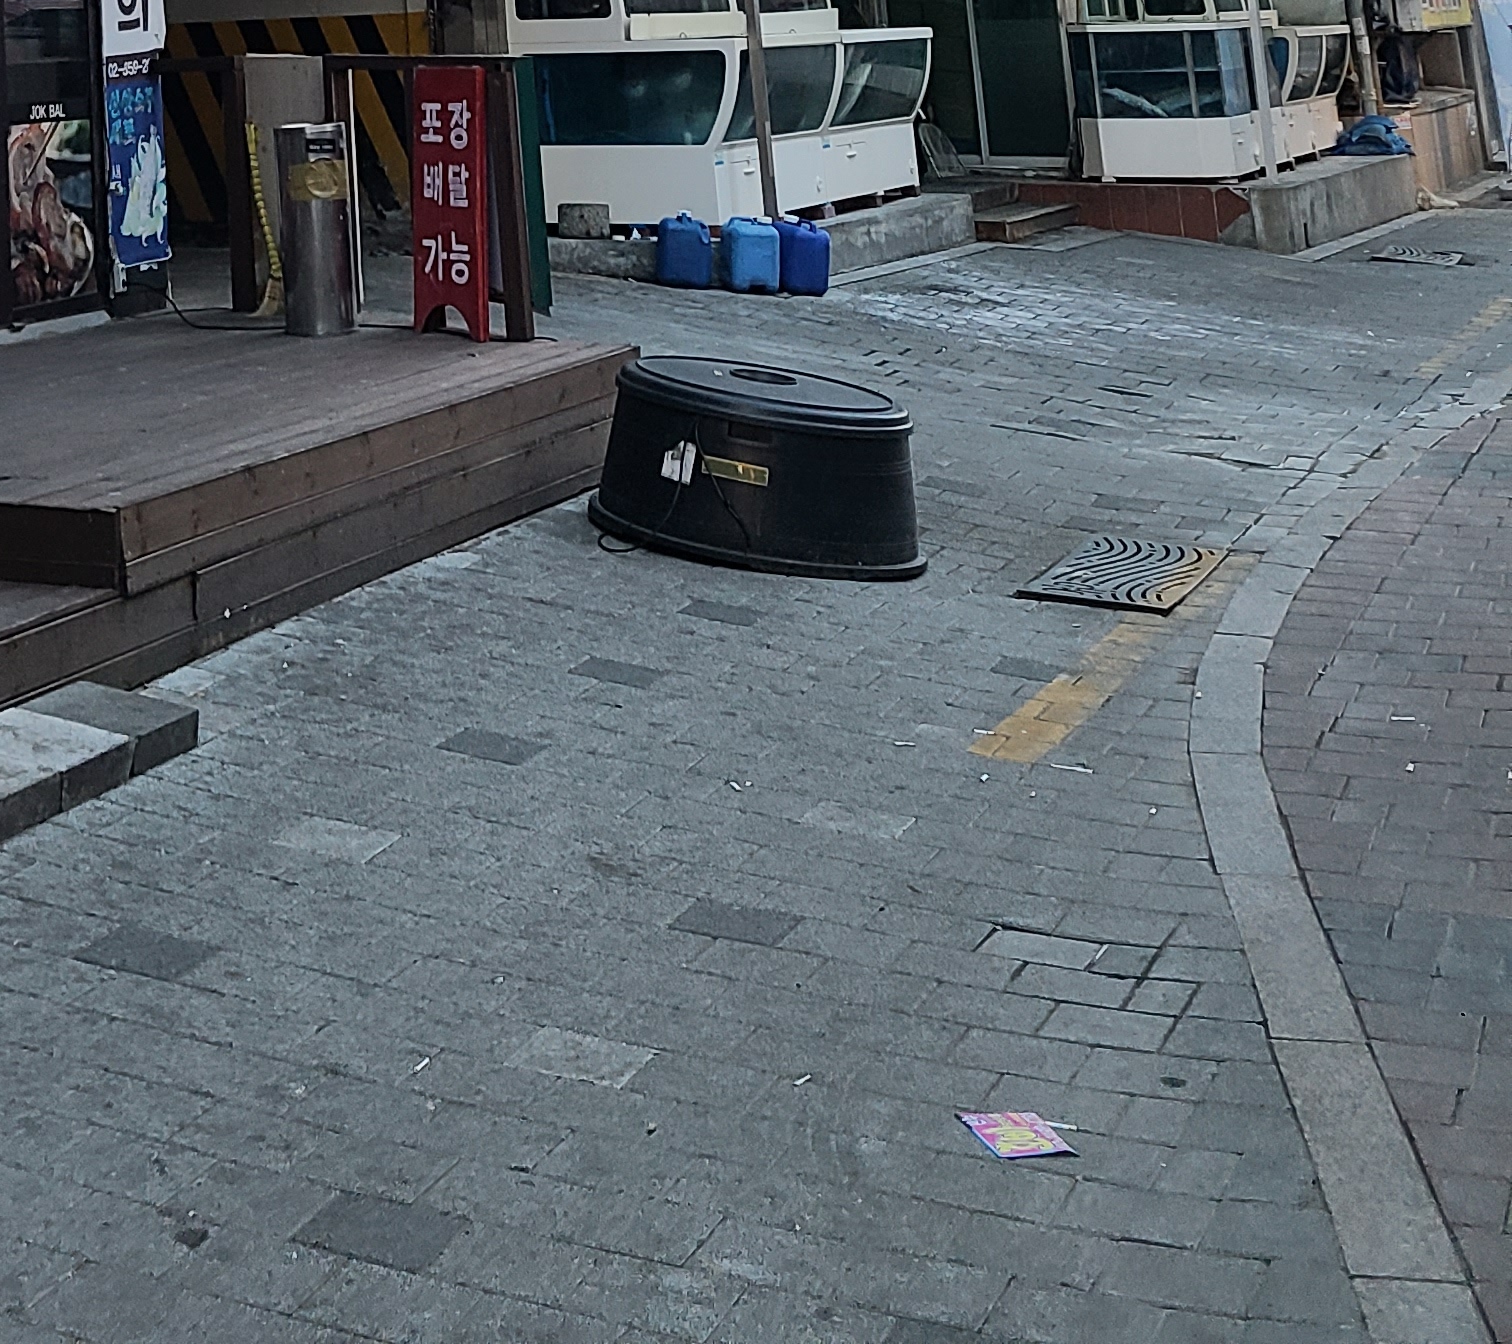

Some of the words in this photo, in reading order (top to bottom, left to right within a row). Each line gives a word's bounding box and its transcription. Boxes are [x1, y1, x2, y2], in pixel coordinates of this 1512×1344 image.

[29, 105, 47, 121] JOK
[48, 103, 66, 119] BAL
[420, 99, 472, 150] 포장
[423, 161, 470, 208] 배달
[422, 230, 471, 285] 가능
